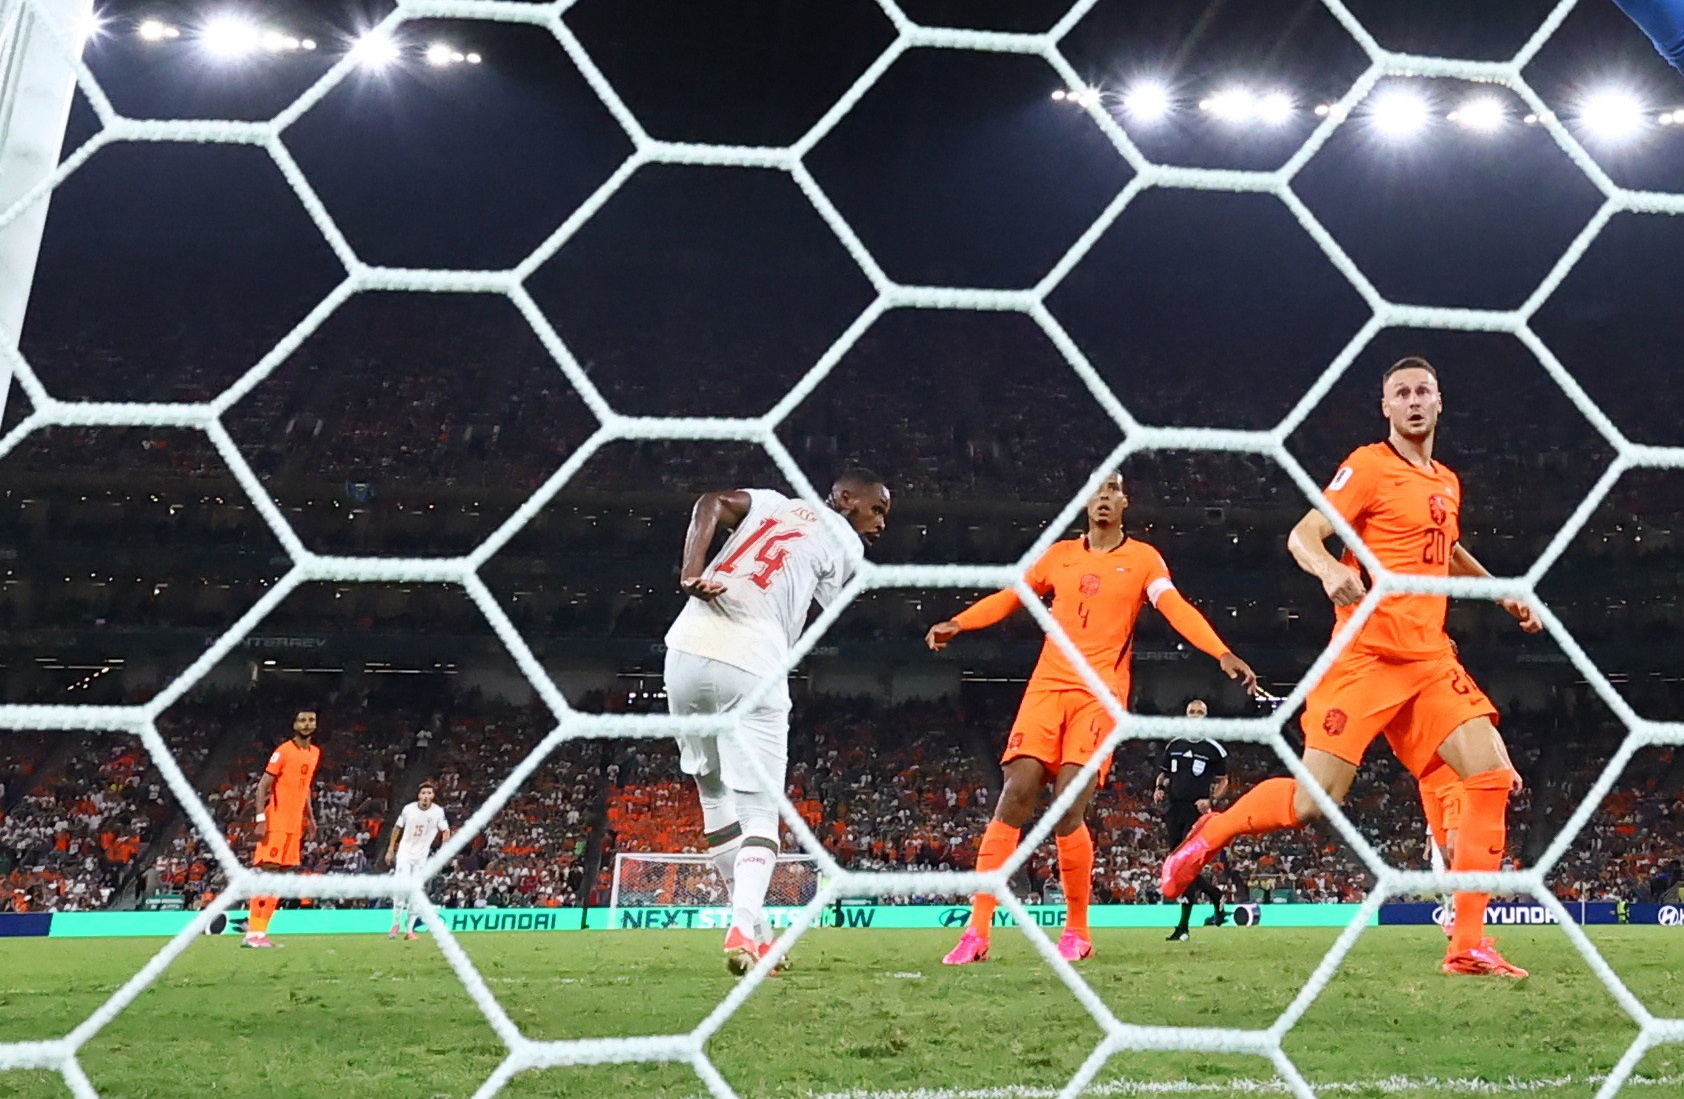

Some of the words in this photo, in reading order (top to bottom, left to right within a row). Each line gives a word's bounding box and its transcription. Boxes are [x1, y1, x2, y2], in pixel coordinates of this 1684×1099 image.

[714, 518, 804, 590] 14
[1423, 528, 1445, 565] 20
[1078, 601, 1090, 630] 4
[452, 913, 556, 930] HYUNDAI
